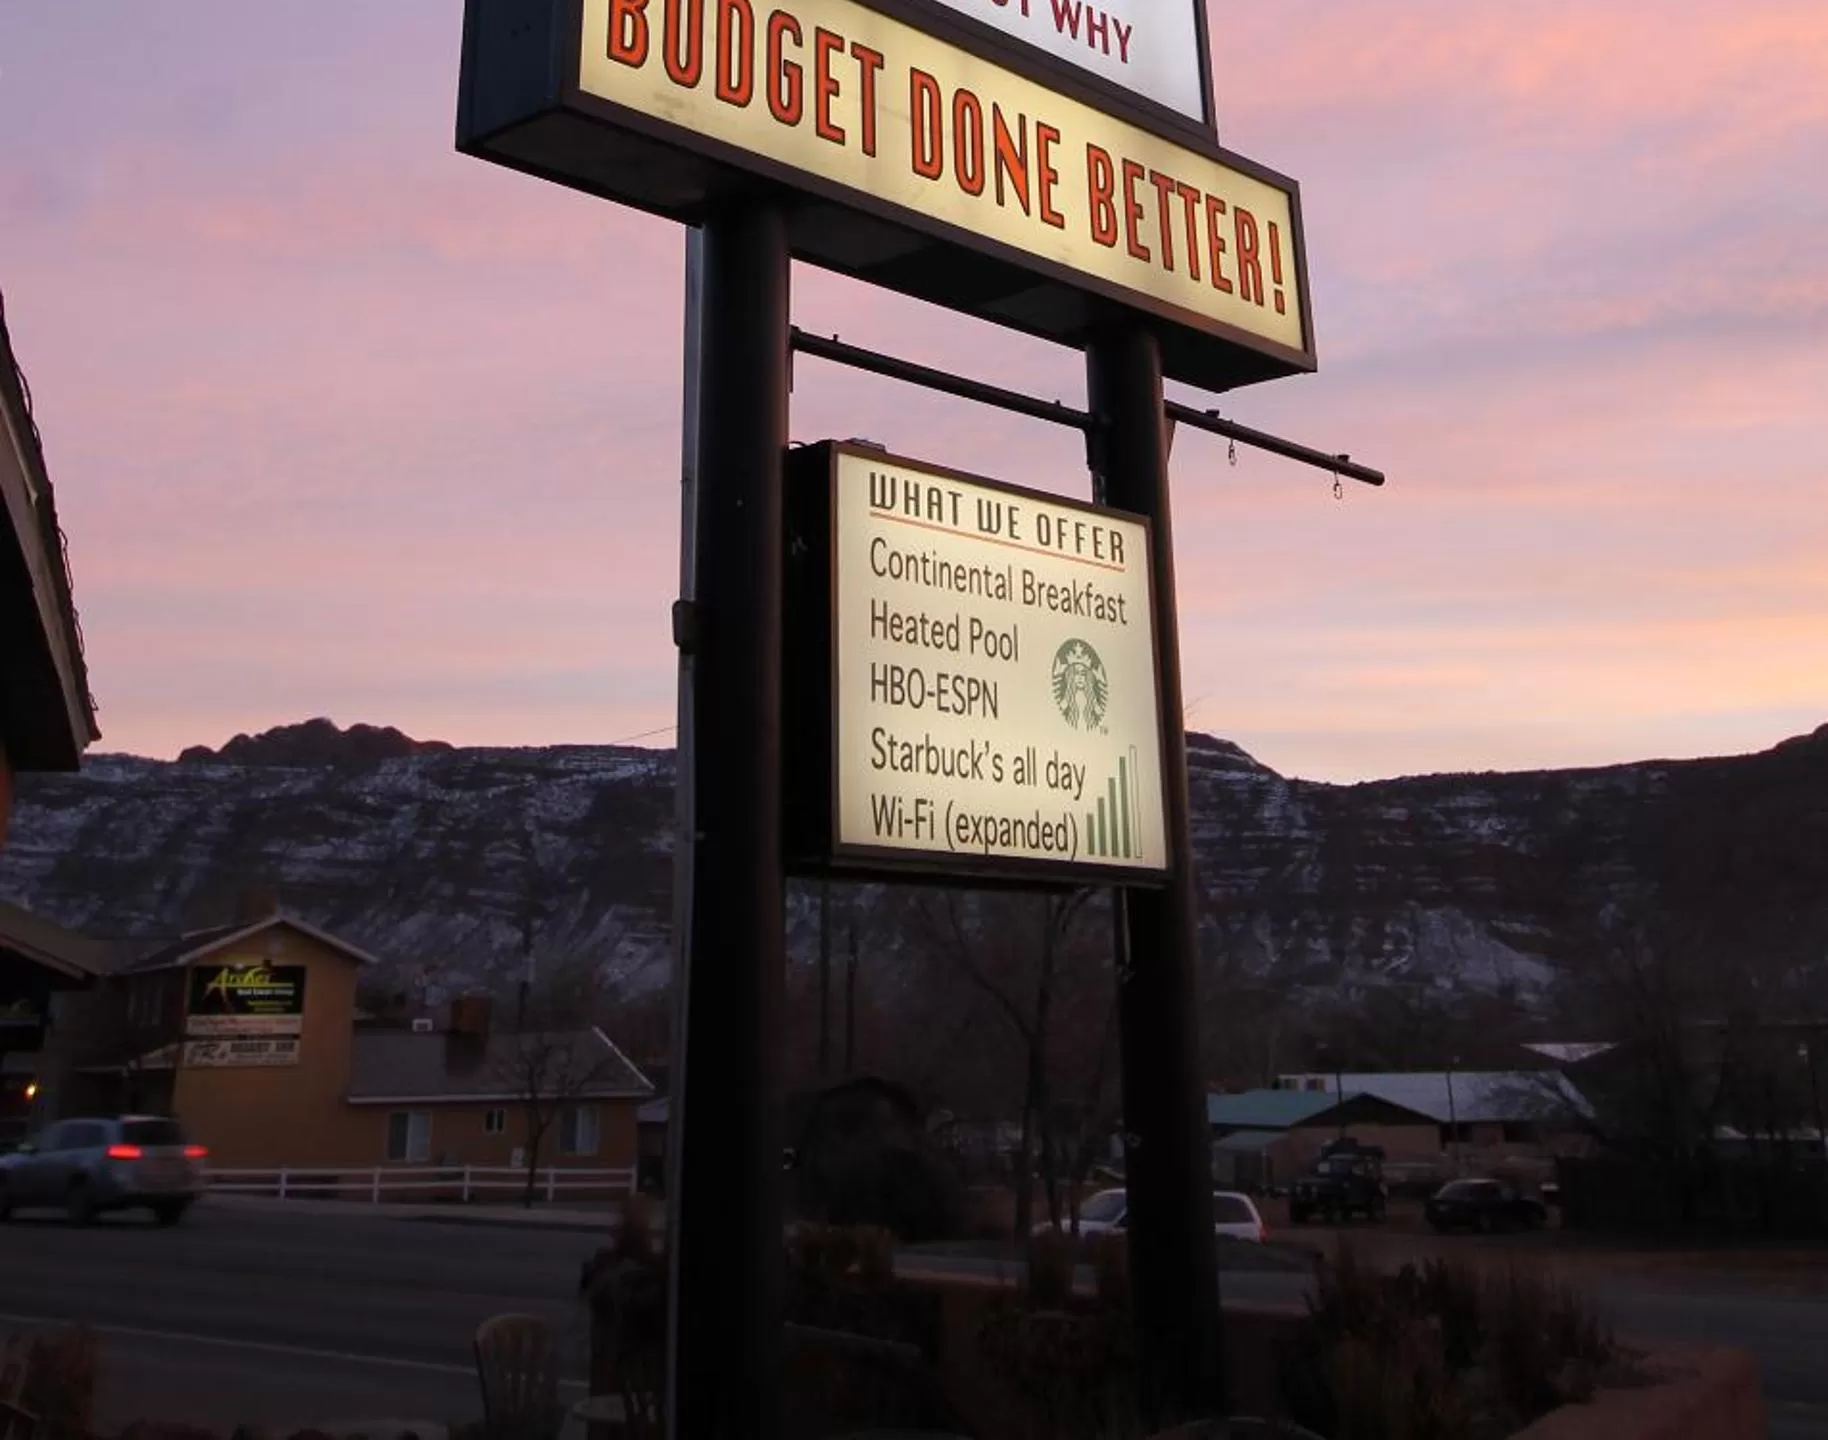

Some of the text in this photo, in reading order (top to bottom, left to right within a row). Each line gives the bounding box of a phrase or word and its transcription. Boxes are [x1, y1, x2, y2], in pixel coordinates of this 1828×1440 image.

[909, 66, 1066, 231] DONE
[1086, 142, 1287, 316] BETTER!
[869, 471, 1126, 564] WHAT WE OFFER
[870, 536, 1128, 625] Continental Breakfast
[870, 599, 1019, 662] Heated Pool
[870, 662, 999, 719] HBO-ESPN
[871, 727, 1086, 800] Starbuck's all day
[871, 793, 1078, 860] Wi-Fi (expanded)
